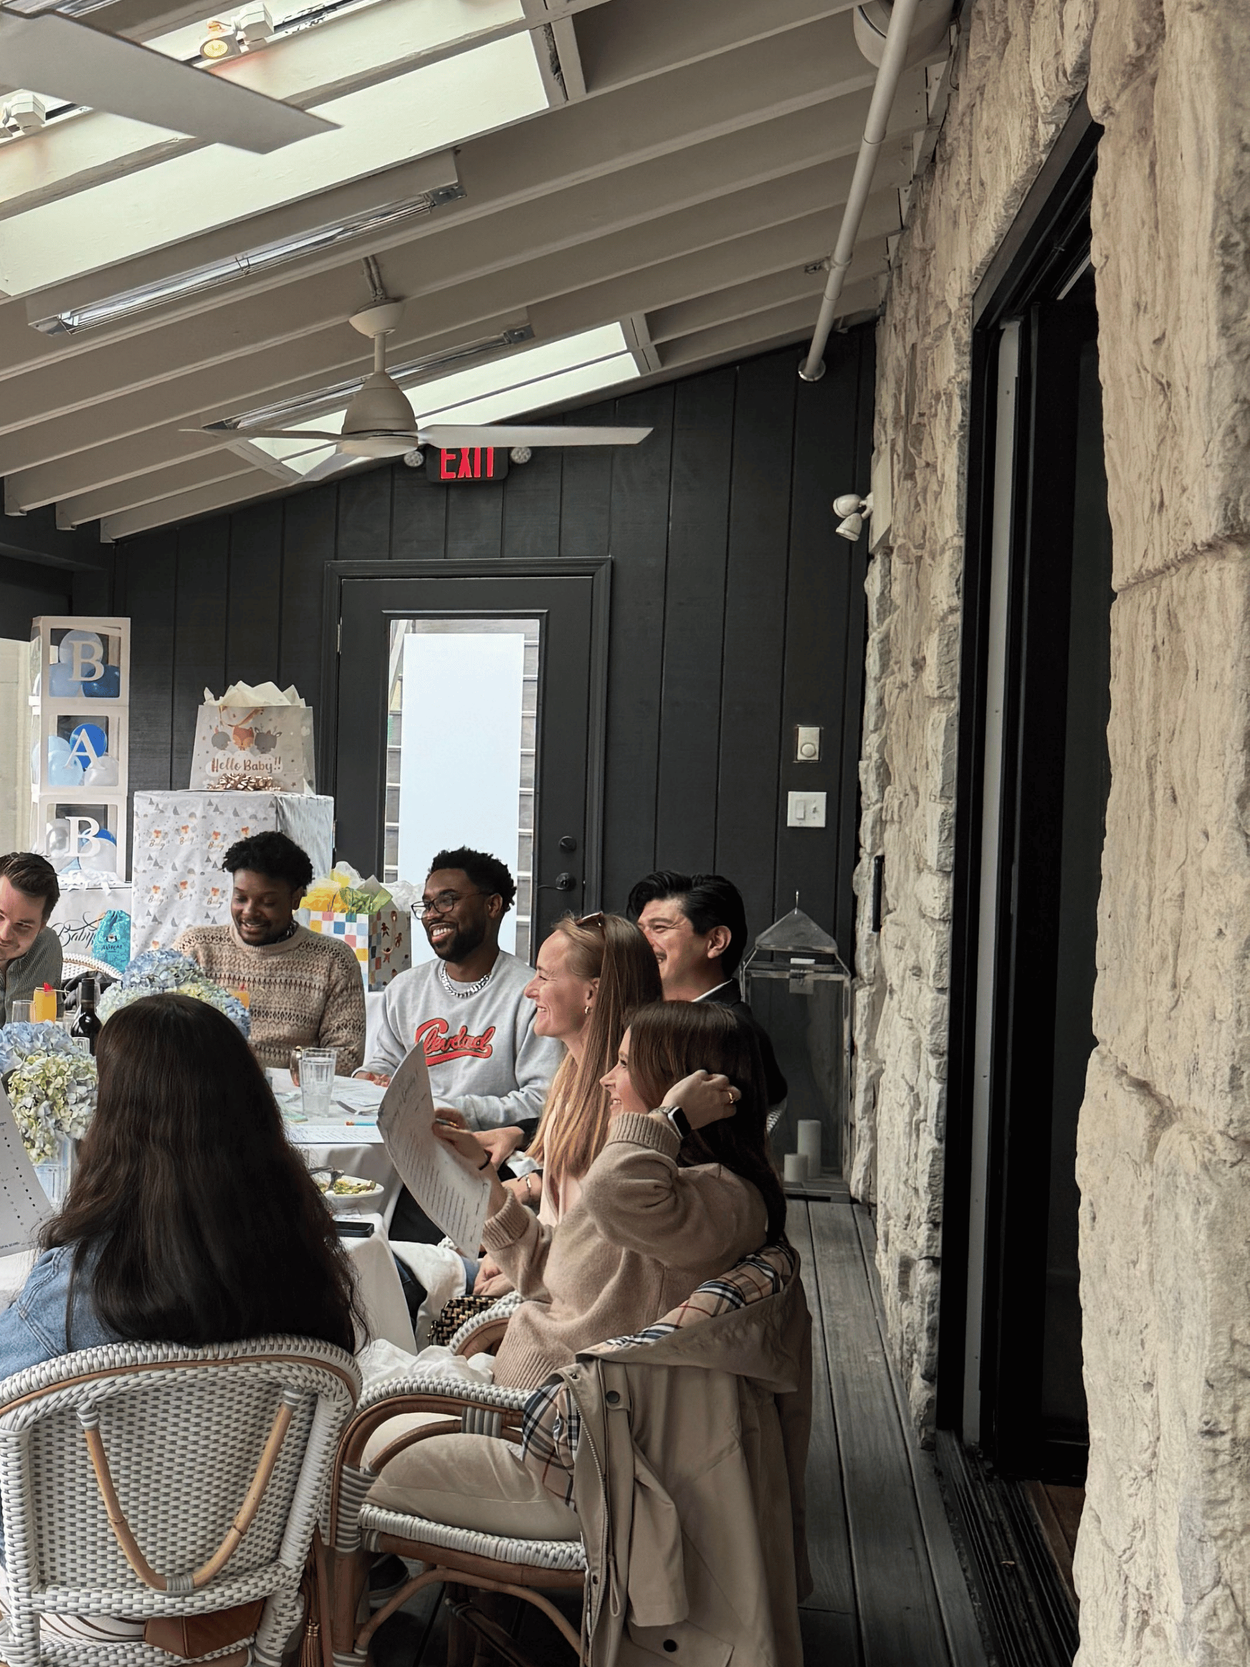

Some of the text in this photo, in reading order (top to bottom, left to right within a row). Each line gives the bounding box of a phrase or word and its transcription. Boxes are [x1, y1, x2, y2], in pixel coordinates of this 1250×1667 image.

[440, 447, 494, 479] EXIT
[68, 639, 105, 682] B
[63, 728, 107, 770] A
[211, 757, 241, 773] Hello
[65, 816, 102, 858] B
